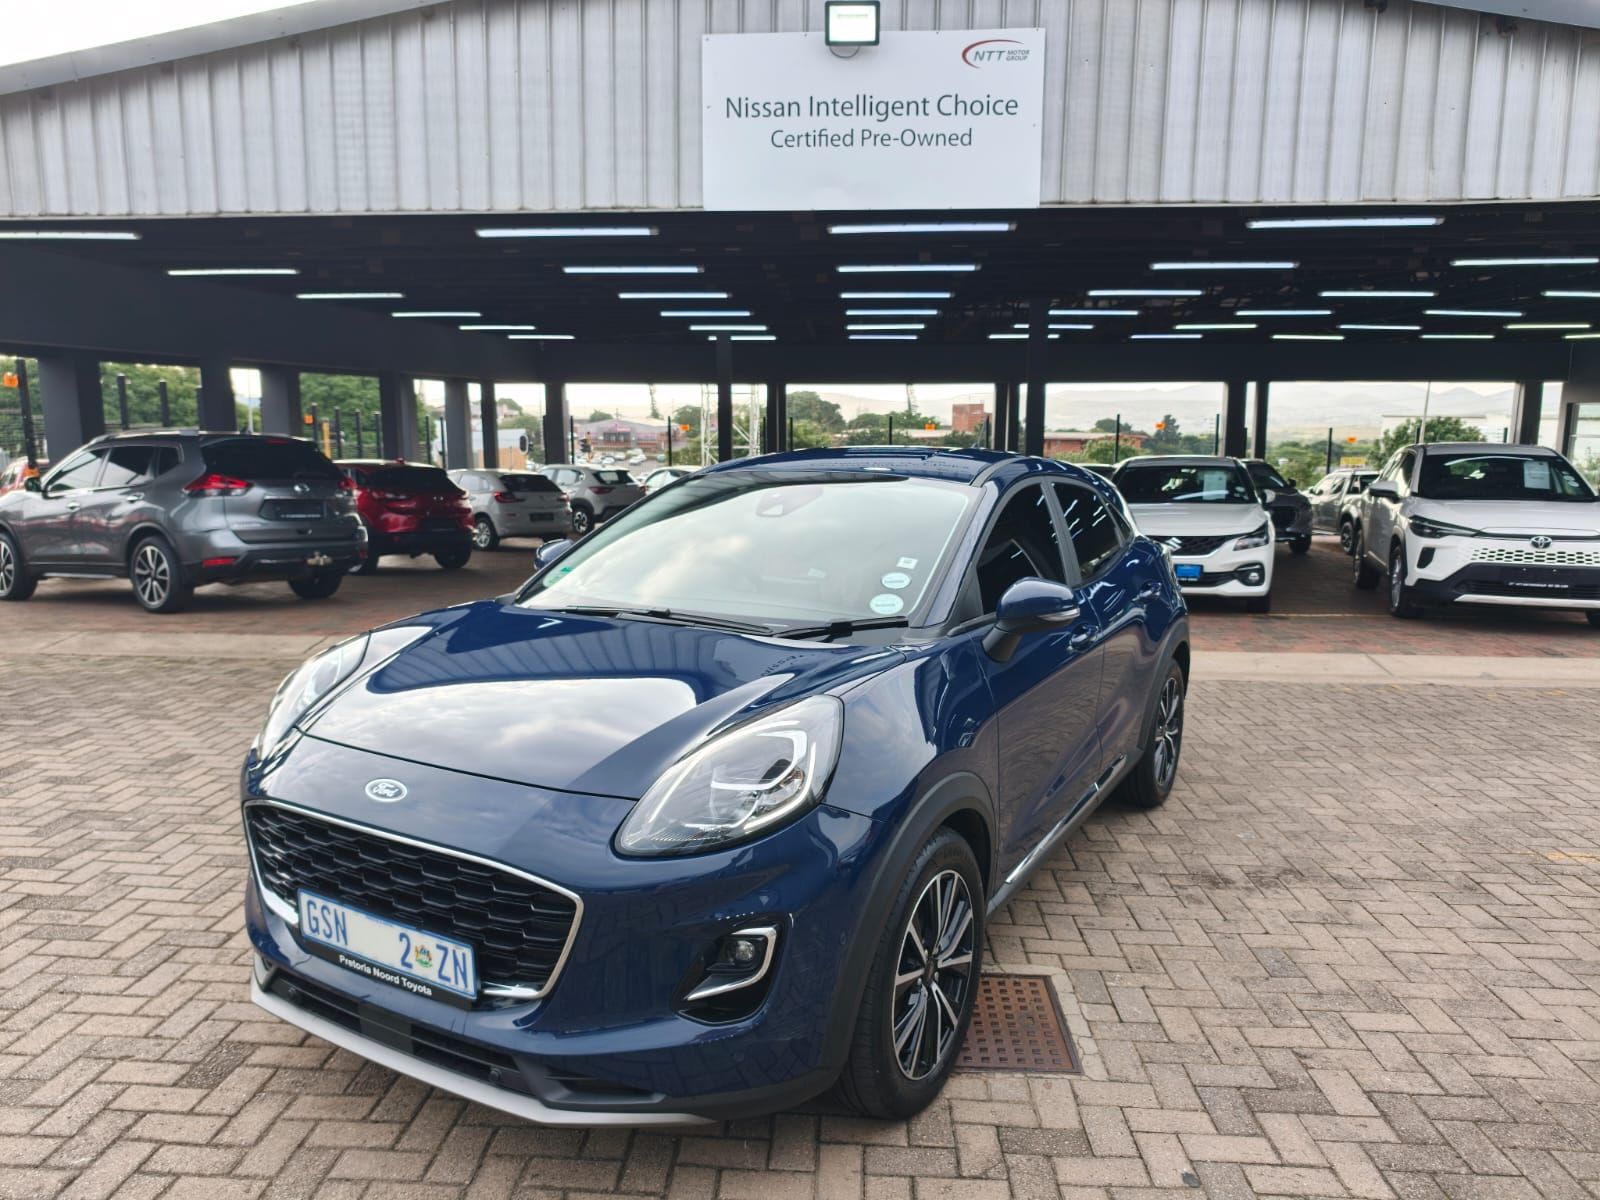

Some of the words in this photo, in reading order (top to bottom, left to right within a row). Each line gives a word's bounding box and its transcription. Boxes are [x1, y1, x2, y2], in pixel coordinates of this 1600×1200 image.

[974, 50, 1006, 61] NTT
[725, 97, 801, 118] Nissan
[809, 95, 930, 122] Intelligent
[936, 95, 1019, 116] Choice
[771, 128, 854, 148] Certified
[861, 128, 972, 146] Pre-Owned
[306, 899, 348, 946] GSN
[399, 932, 413, 969] 2
[435, 943, 468, 989] ZN
[339, 954, 372, 975] Pretoria
[373, 966, 400, 985] Noord
[401, 976, 433, 996] Toyota
